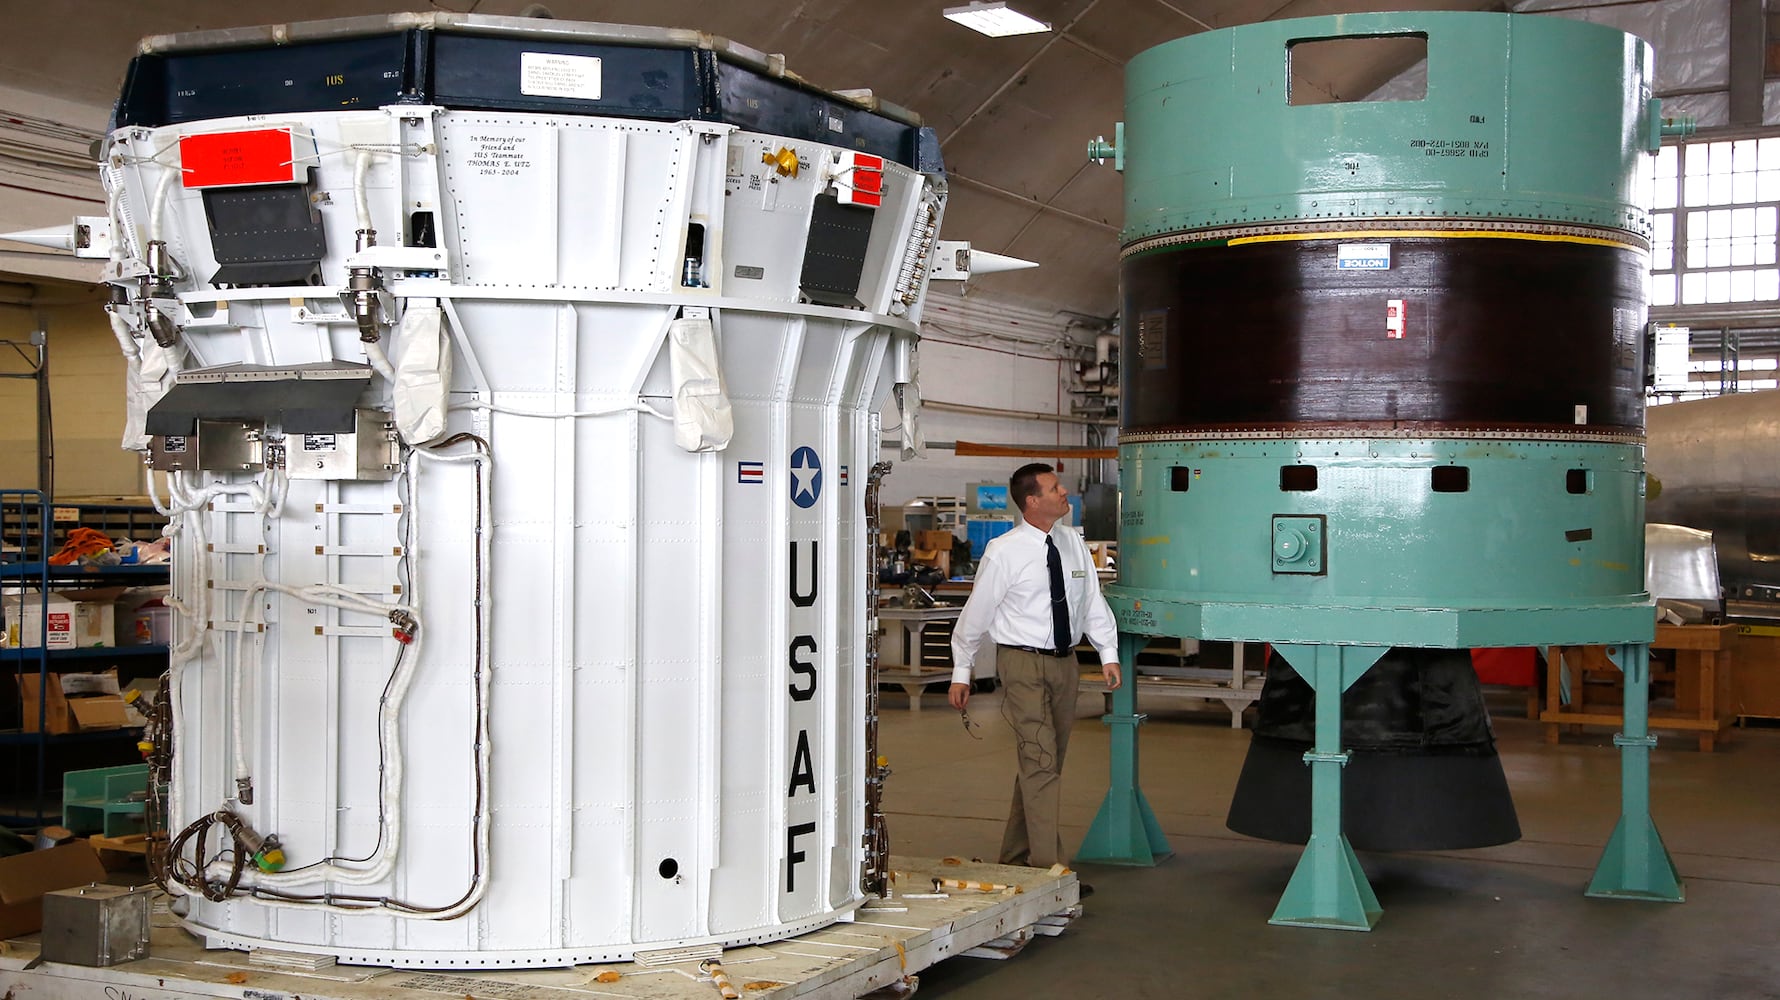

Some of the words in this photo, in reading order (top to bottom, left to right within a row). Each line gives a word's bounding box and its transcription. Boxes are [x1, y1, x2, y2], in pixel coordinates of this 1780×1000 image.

[326, 74, 344, 86] IUS
[480, 135, 506, 144] Memory
[507, 135, 515, 144] of
[480, 143, 502, 151] Friend
[1344, 259, 1383, 268] NOTICE
[787, 541, 818, 893] USAF
